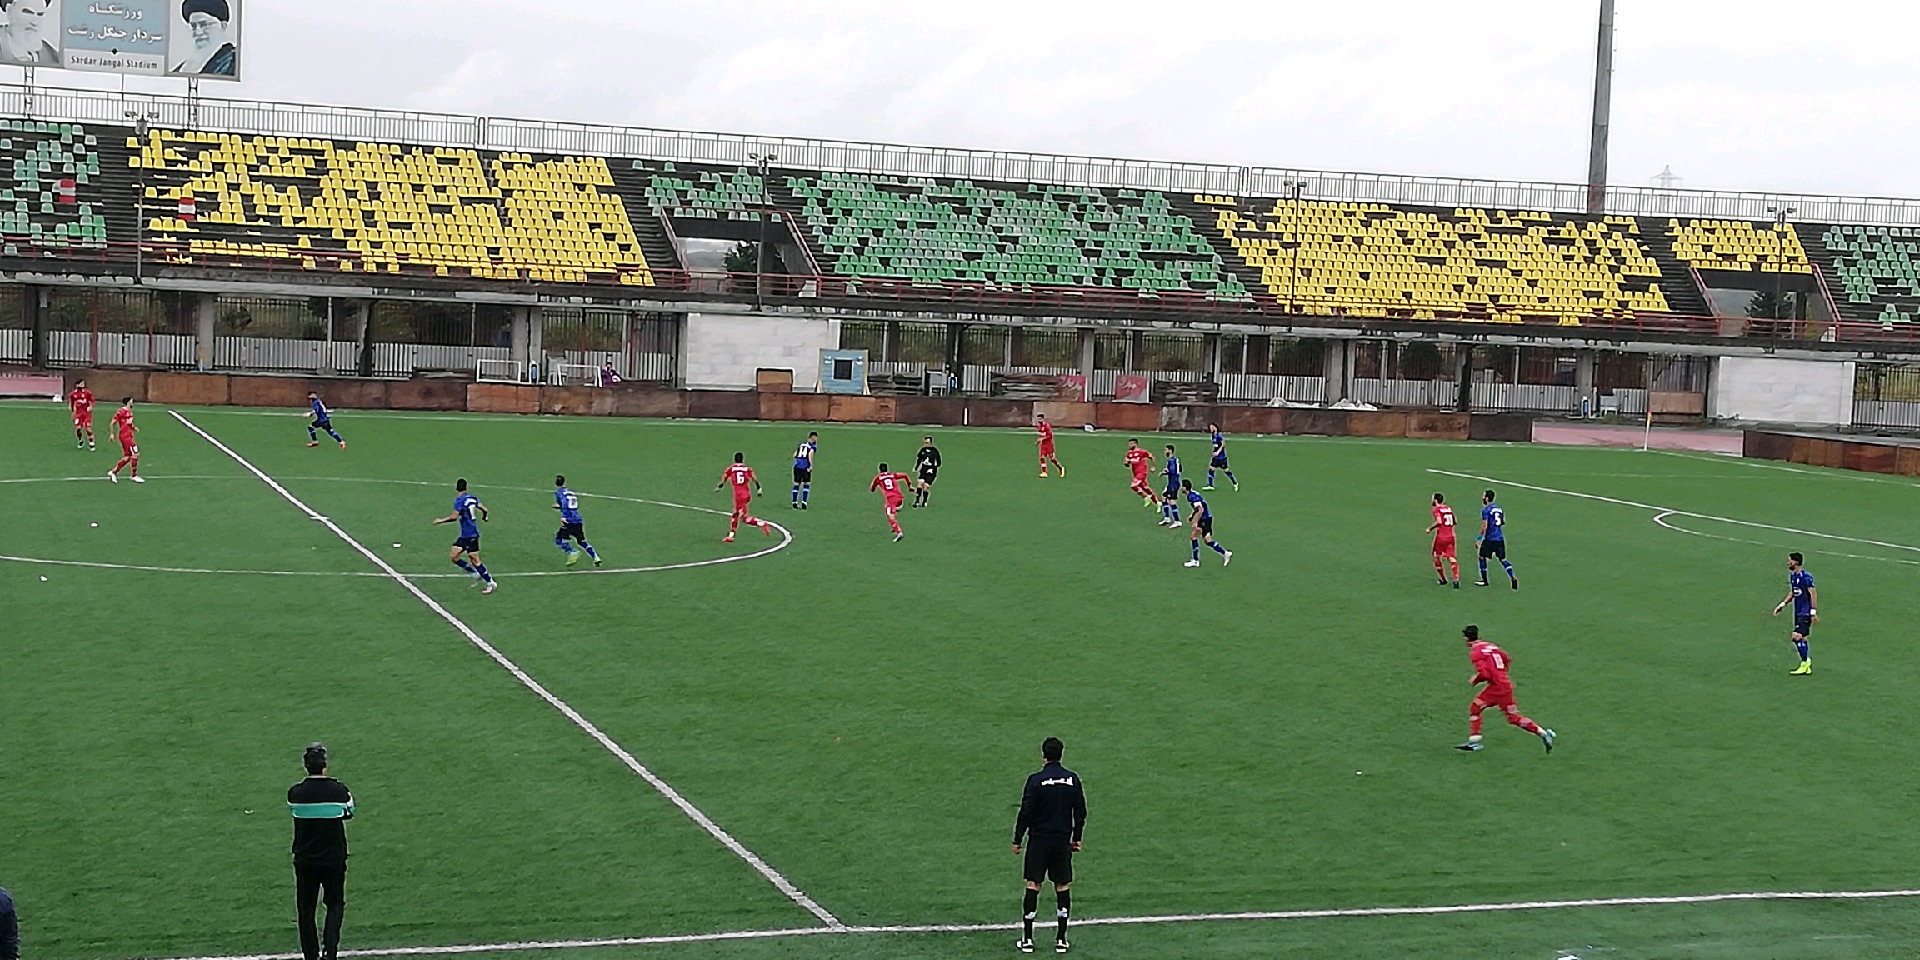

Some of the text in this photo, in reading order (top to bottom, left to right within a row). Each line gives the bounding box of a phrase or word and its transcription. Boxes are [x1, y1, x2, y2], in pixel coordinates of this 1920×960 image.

[71, 55, 158, 69] Sardar Jangal Stadium
[737, 471, 745, 484] 6
[884, 477, 893, 489] 9
[1494, 513, 1501, 526] 5
